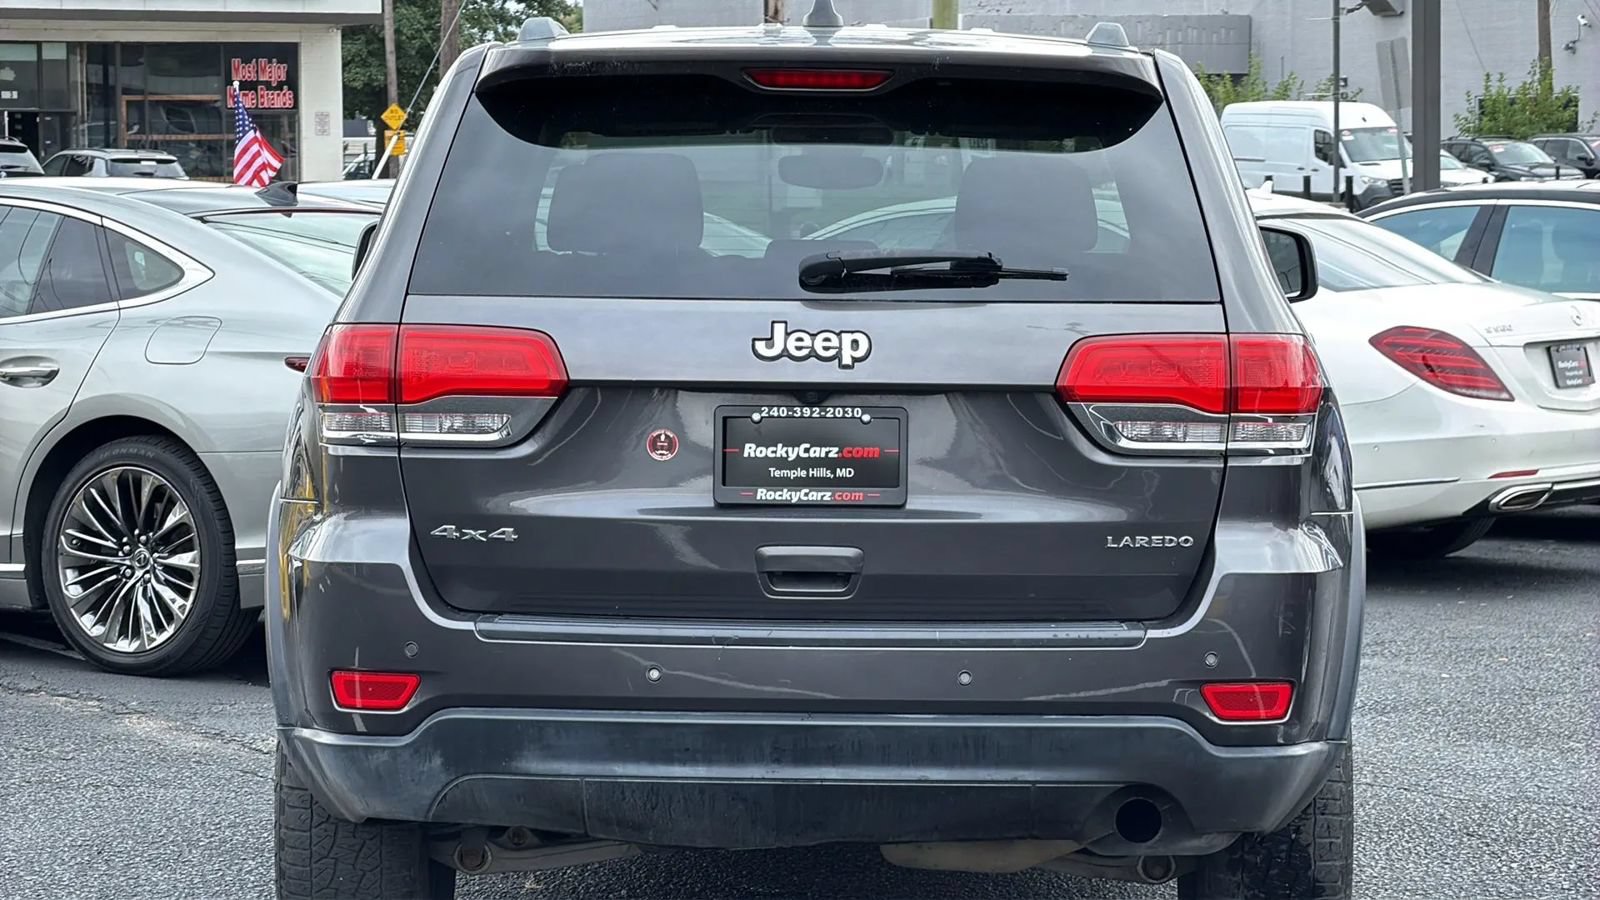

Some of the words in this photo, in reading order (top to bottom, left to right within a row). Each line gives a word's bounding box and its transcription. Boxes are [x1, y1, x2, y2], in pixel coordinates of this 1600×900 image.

[231, 58, 257, 81] Most
[258, 58, 287, 86] Major
[226, 85, 256, 108] Nme
[257, 85, 294, 108] Brands
[752, 320, 872, 369] Jeep
[760, 406, 863, 418] 240-392-2030
[743, 442, 881, 461] RockyCarz.com
[768, 467, 807, 480] Temple
[809, 467, 834, 479] Hills,
[835, 468, 855, 478] MD
[756, 488, 864, 503] RockyCarz.com
[430, 524, 519, 541] 4x4
[1106, 535, 1194, 547] LAREDO
